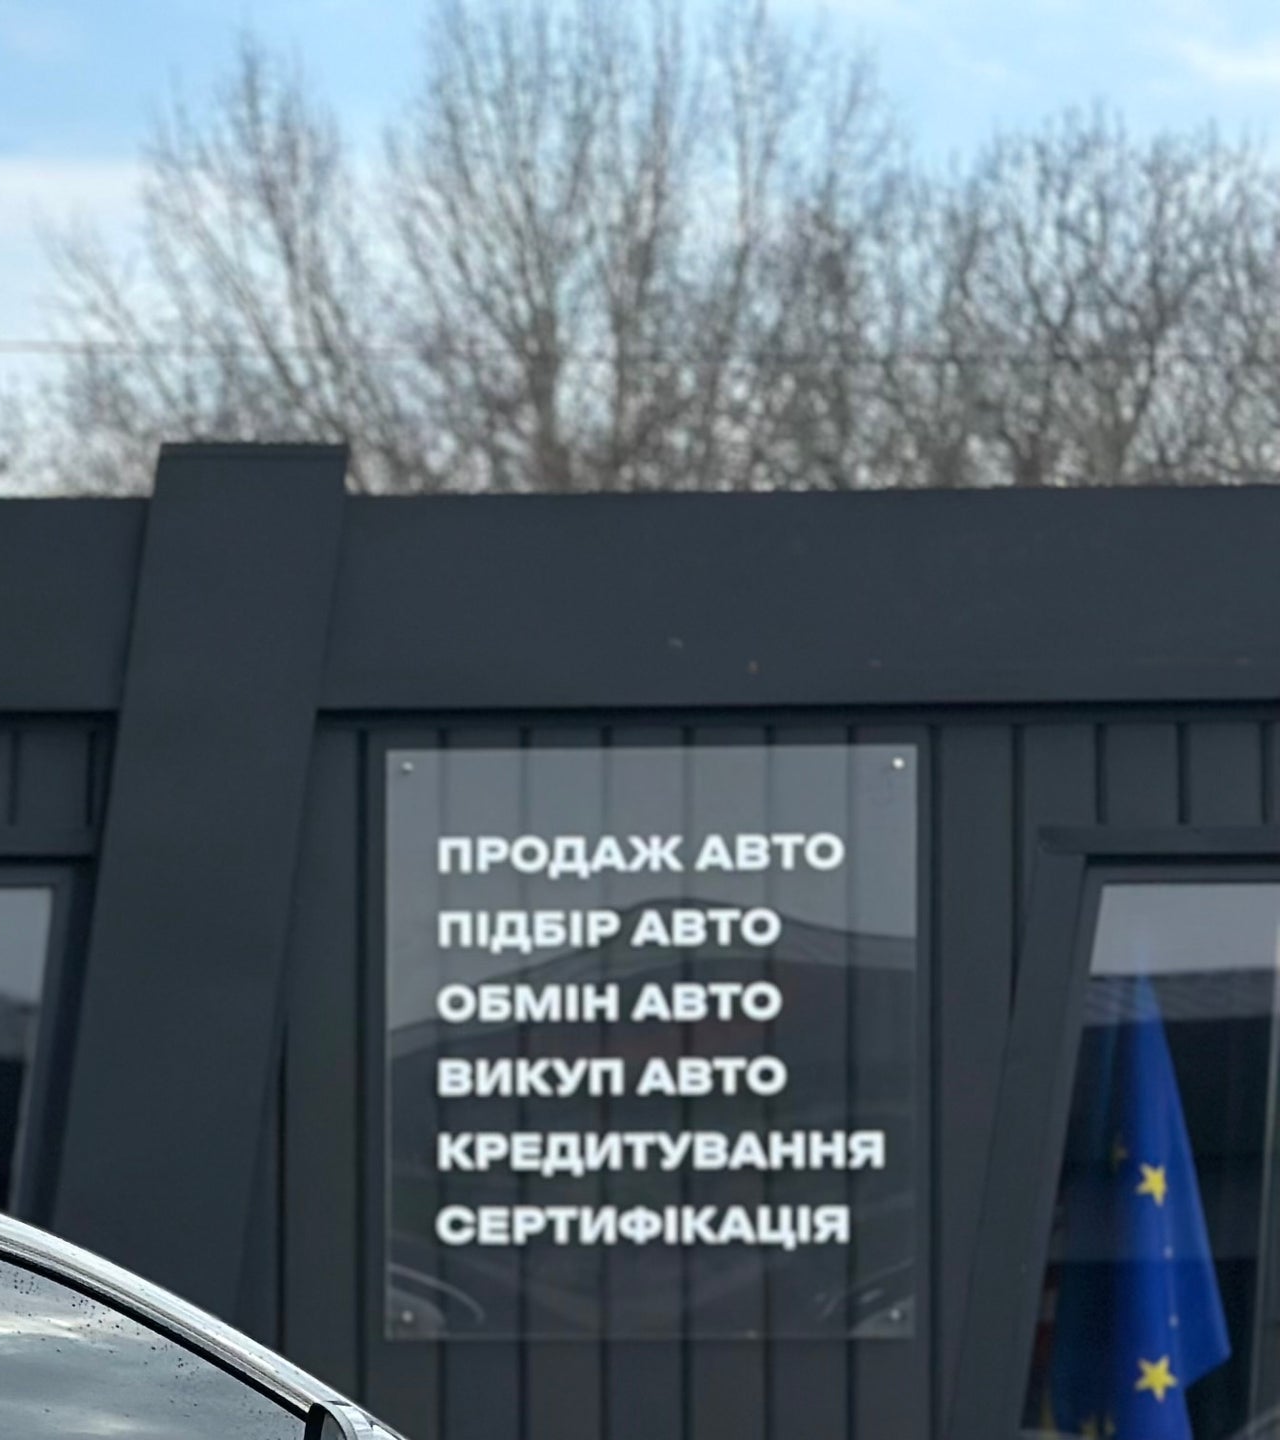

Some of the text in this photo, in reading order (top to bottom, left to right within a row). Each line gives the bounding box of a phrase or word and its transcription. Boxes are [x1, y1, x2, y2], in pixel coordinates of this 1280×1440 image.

[437, 831, 846, 880] ПРОДАЖ АВТО
[437, 907, 782, 954] ПІДБІР АВТО
[435, 981, 783, 1023] ОБМІН АВТО
[437, 1055, 788, 1097] ВИКУП АВТО
[437, 1130, 886, 1177] КРЕДИТУВАННЯ
[435, 1204, 850, 1251] СЕРТИФІКАЦІЯ
